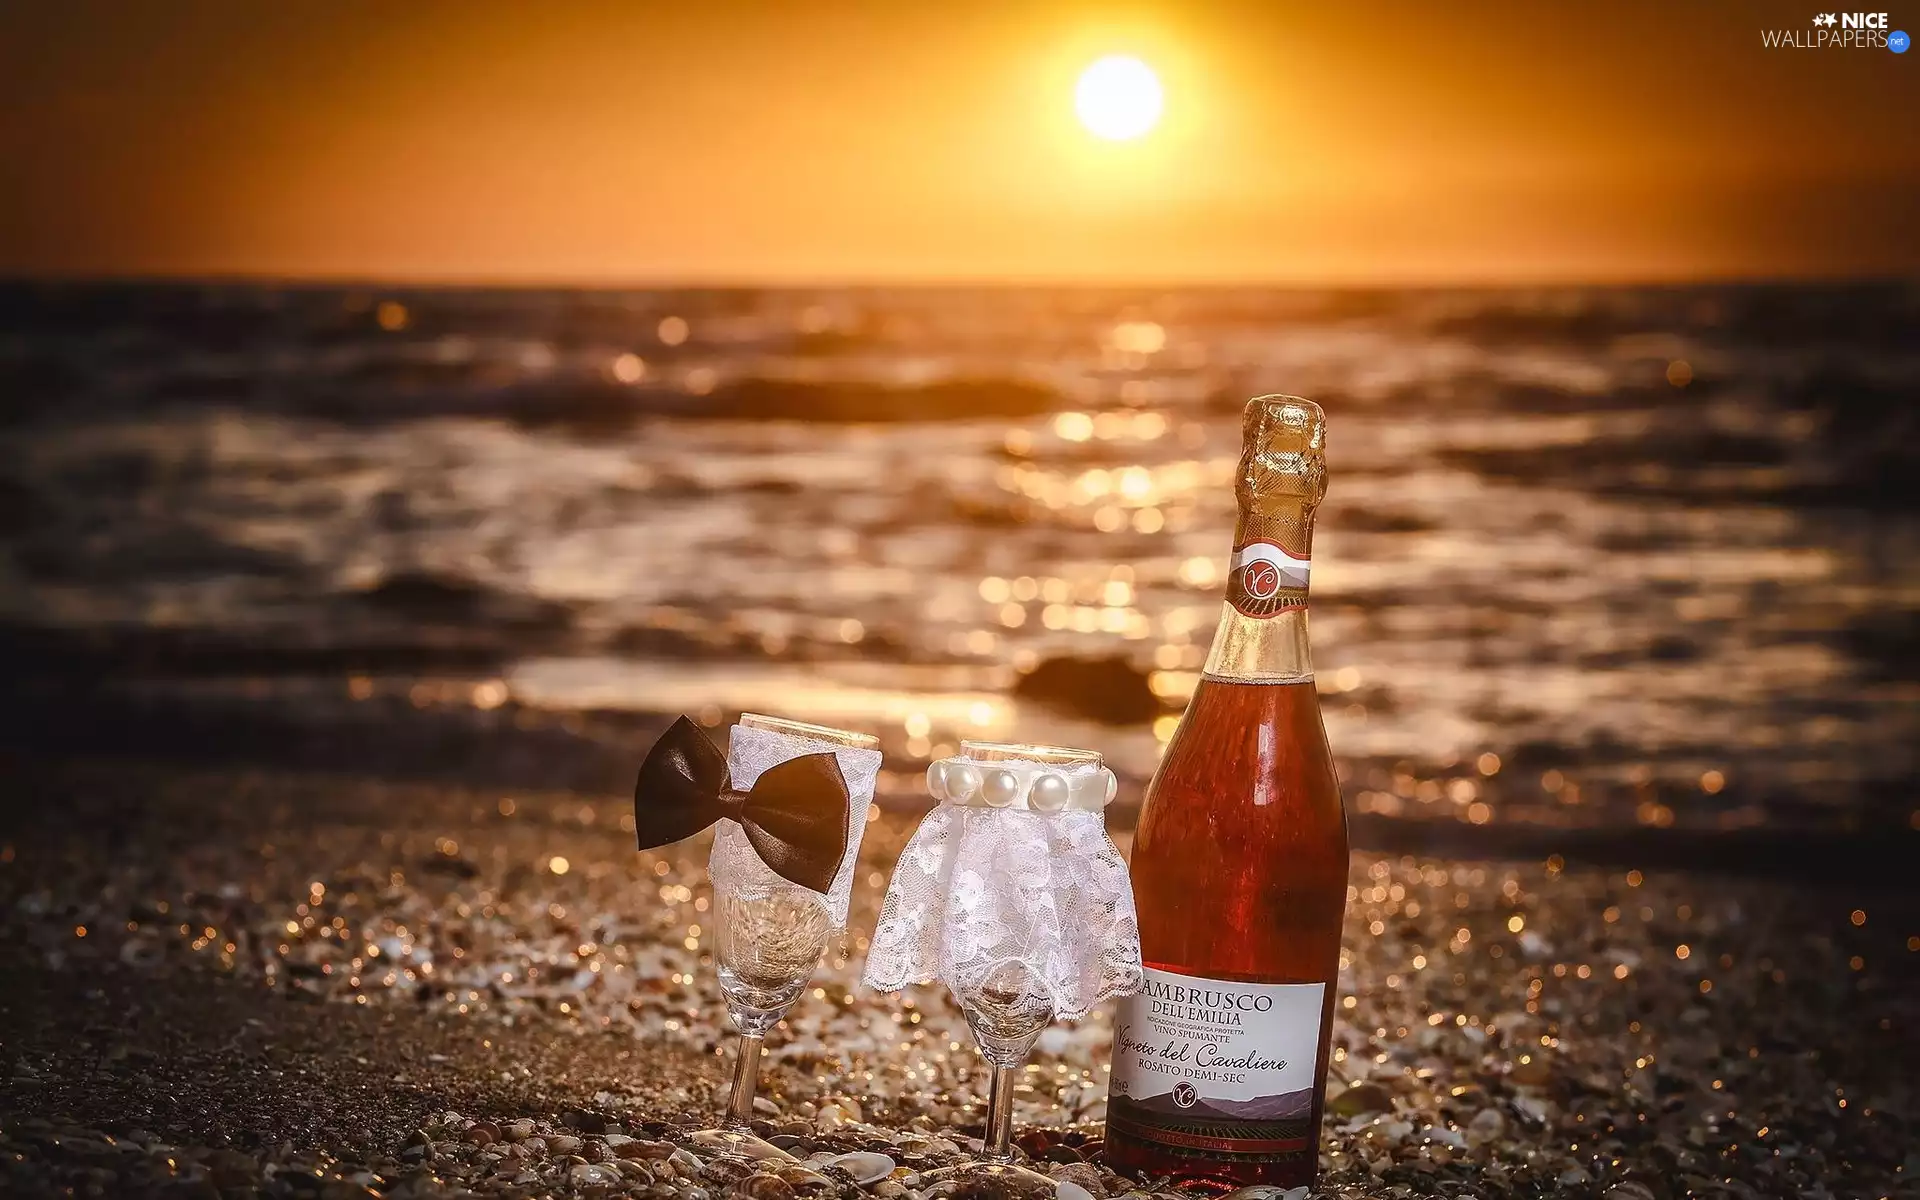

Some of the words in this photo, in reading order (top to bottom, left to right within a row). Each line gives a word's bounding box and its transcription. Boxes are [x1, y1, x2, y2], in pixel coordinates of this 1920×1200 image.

[1151, 1000, 1242, 1026] DELL'EMILIA
[1117, 1024, 1157, 1055] Vigneto
[1159, 1040, 1191, 1062] del
[1195, 1043, 1288, 1070] Cavaliere
[1153, 1024, 1177, 1036] VINO
[1177, 1029, 1231, 1044] SPUMANTE
[1138, 1058, 1181, 1076] ROSATO
[1184, 1068, 1246, 1084] DEMI-SEC
